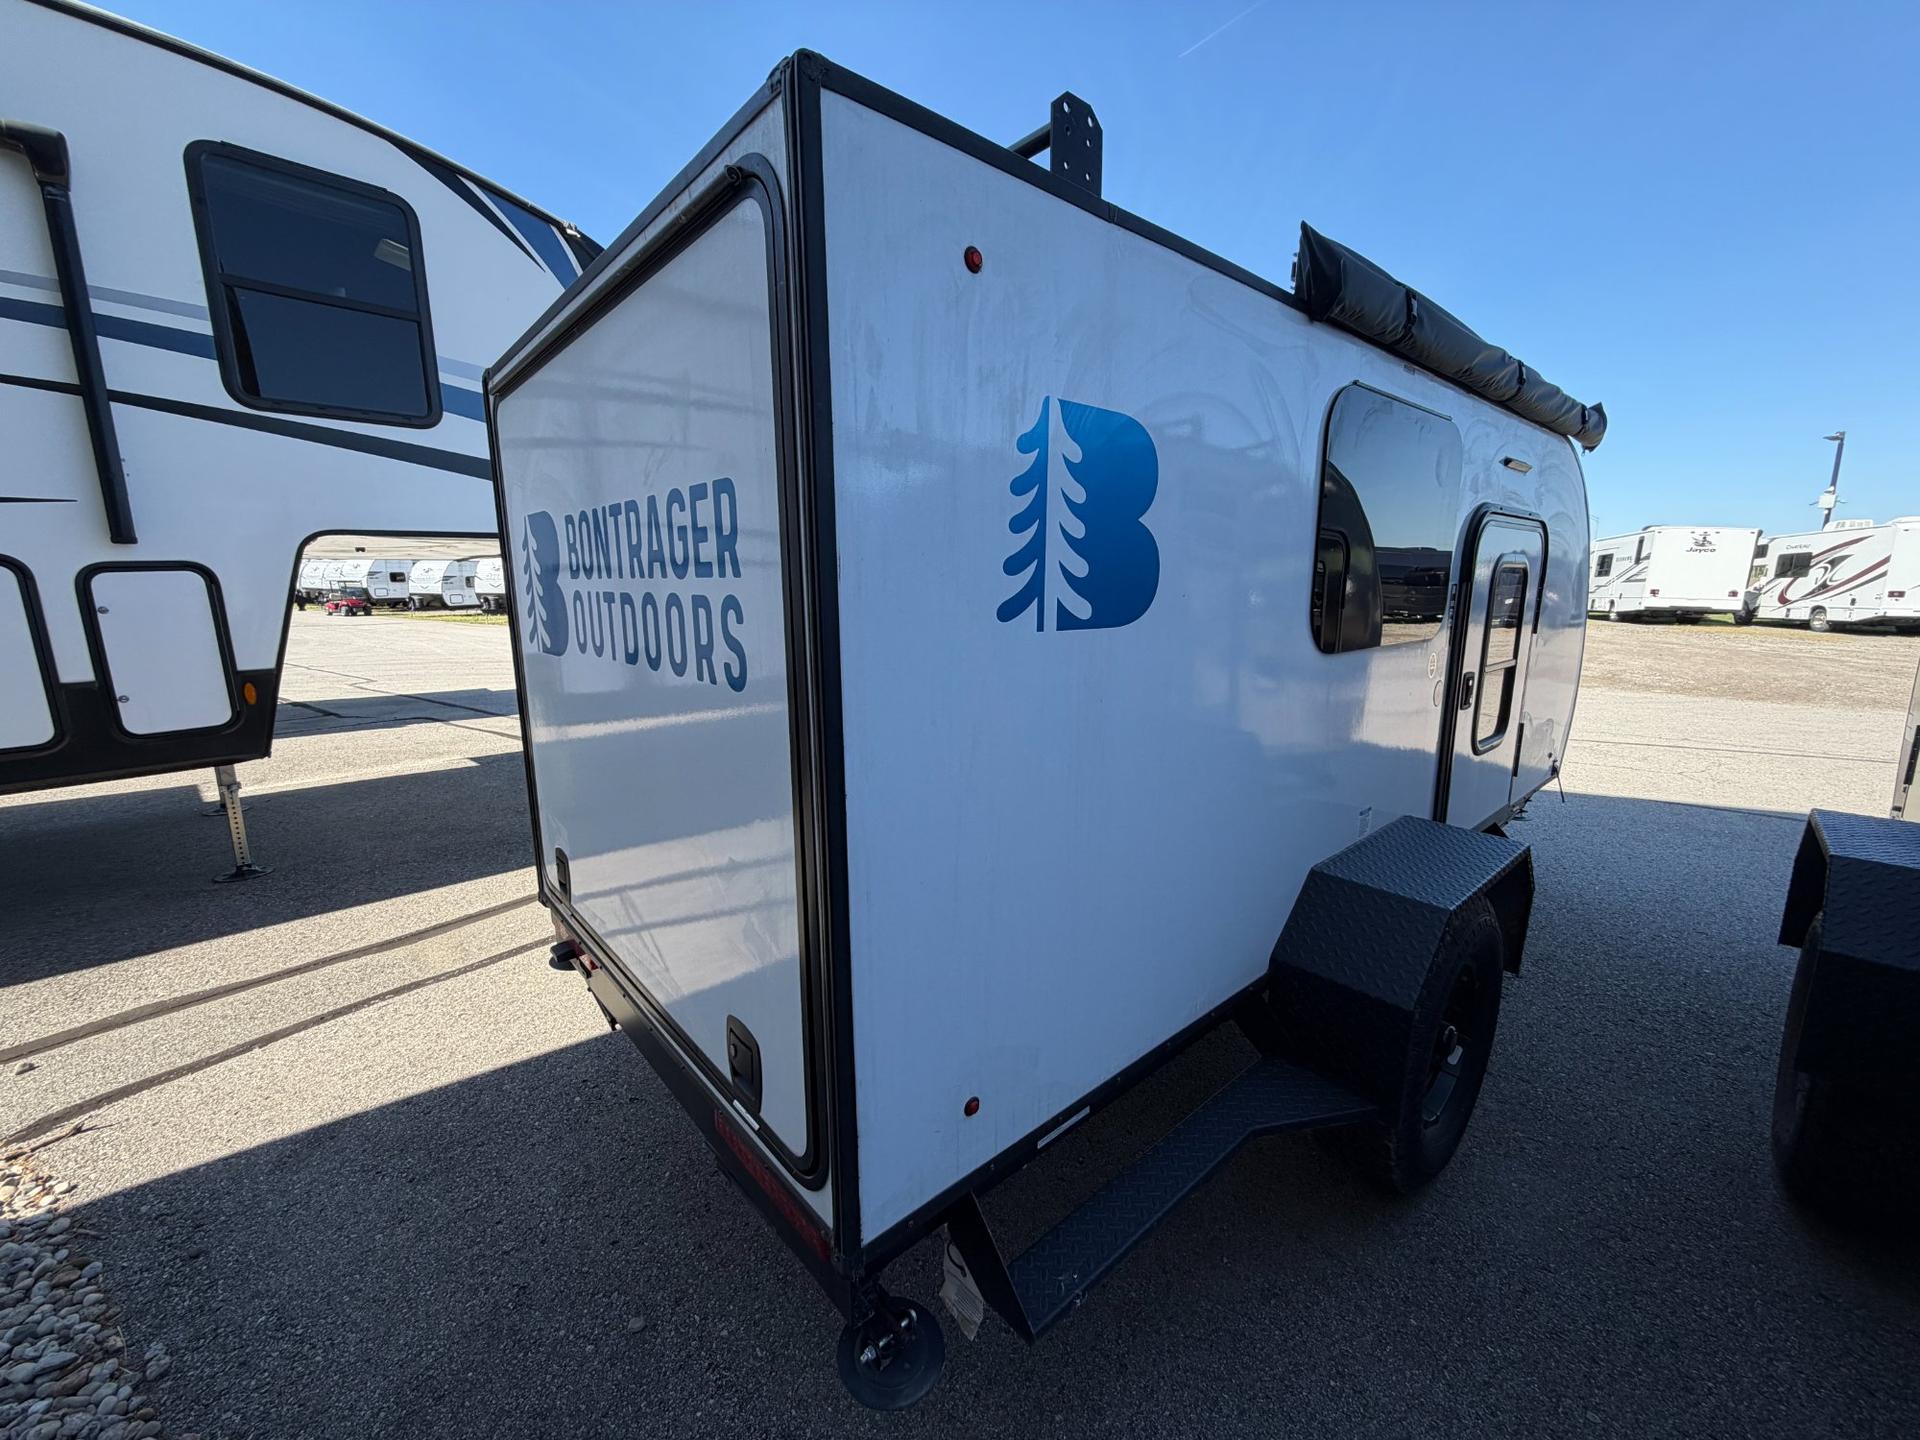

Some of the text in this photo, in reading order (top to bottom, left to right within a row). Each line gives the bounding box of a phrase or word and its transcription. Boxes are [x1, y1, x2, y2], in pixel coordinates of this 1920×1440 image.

[564, 477, 742, 580] BONTRAGER
[1685, 546, 1717, 554] Jayco
[572, 589, 748, 693] OUTDOORS
